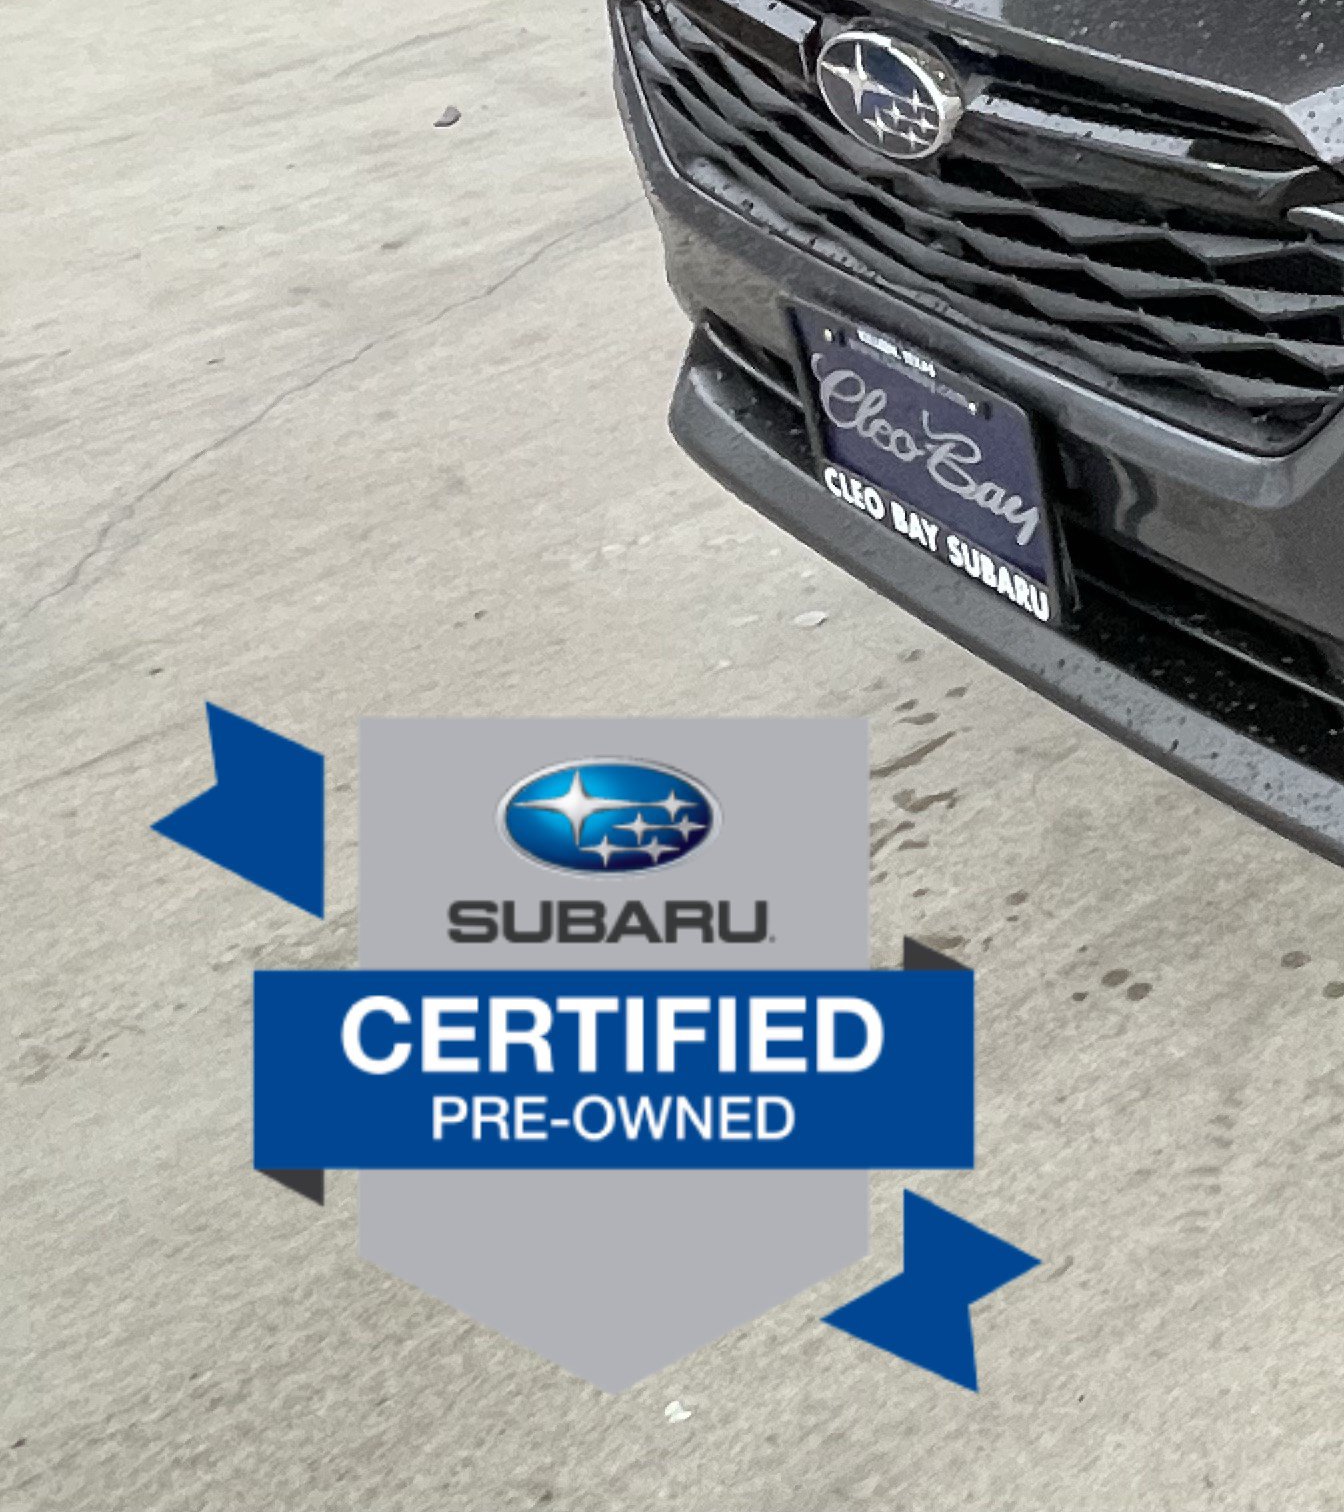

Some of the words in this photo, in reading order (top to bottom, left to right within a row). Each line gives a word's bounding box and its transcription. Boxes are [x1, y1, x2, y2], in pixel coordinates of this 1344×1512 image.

[811, 353, 924, 462] Cleo
[922, 409, 1040, 546] Bay
[824, 467, 886, 520] CLEO
[890, 501, 939, 552] BAY
[947, 534, 1050, 622] SUBARU
